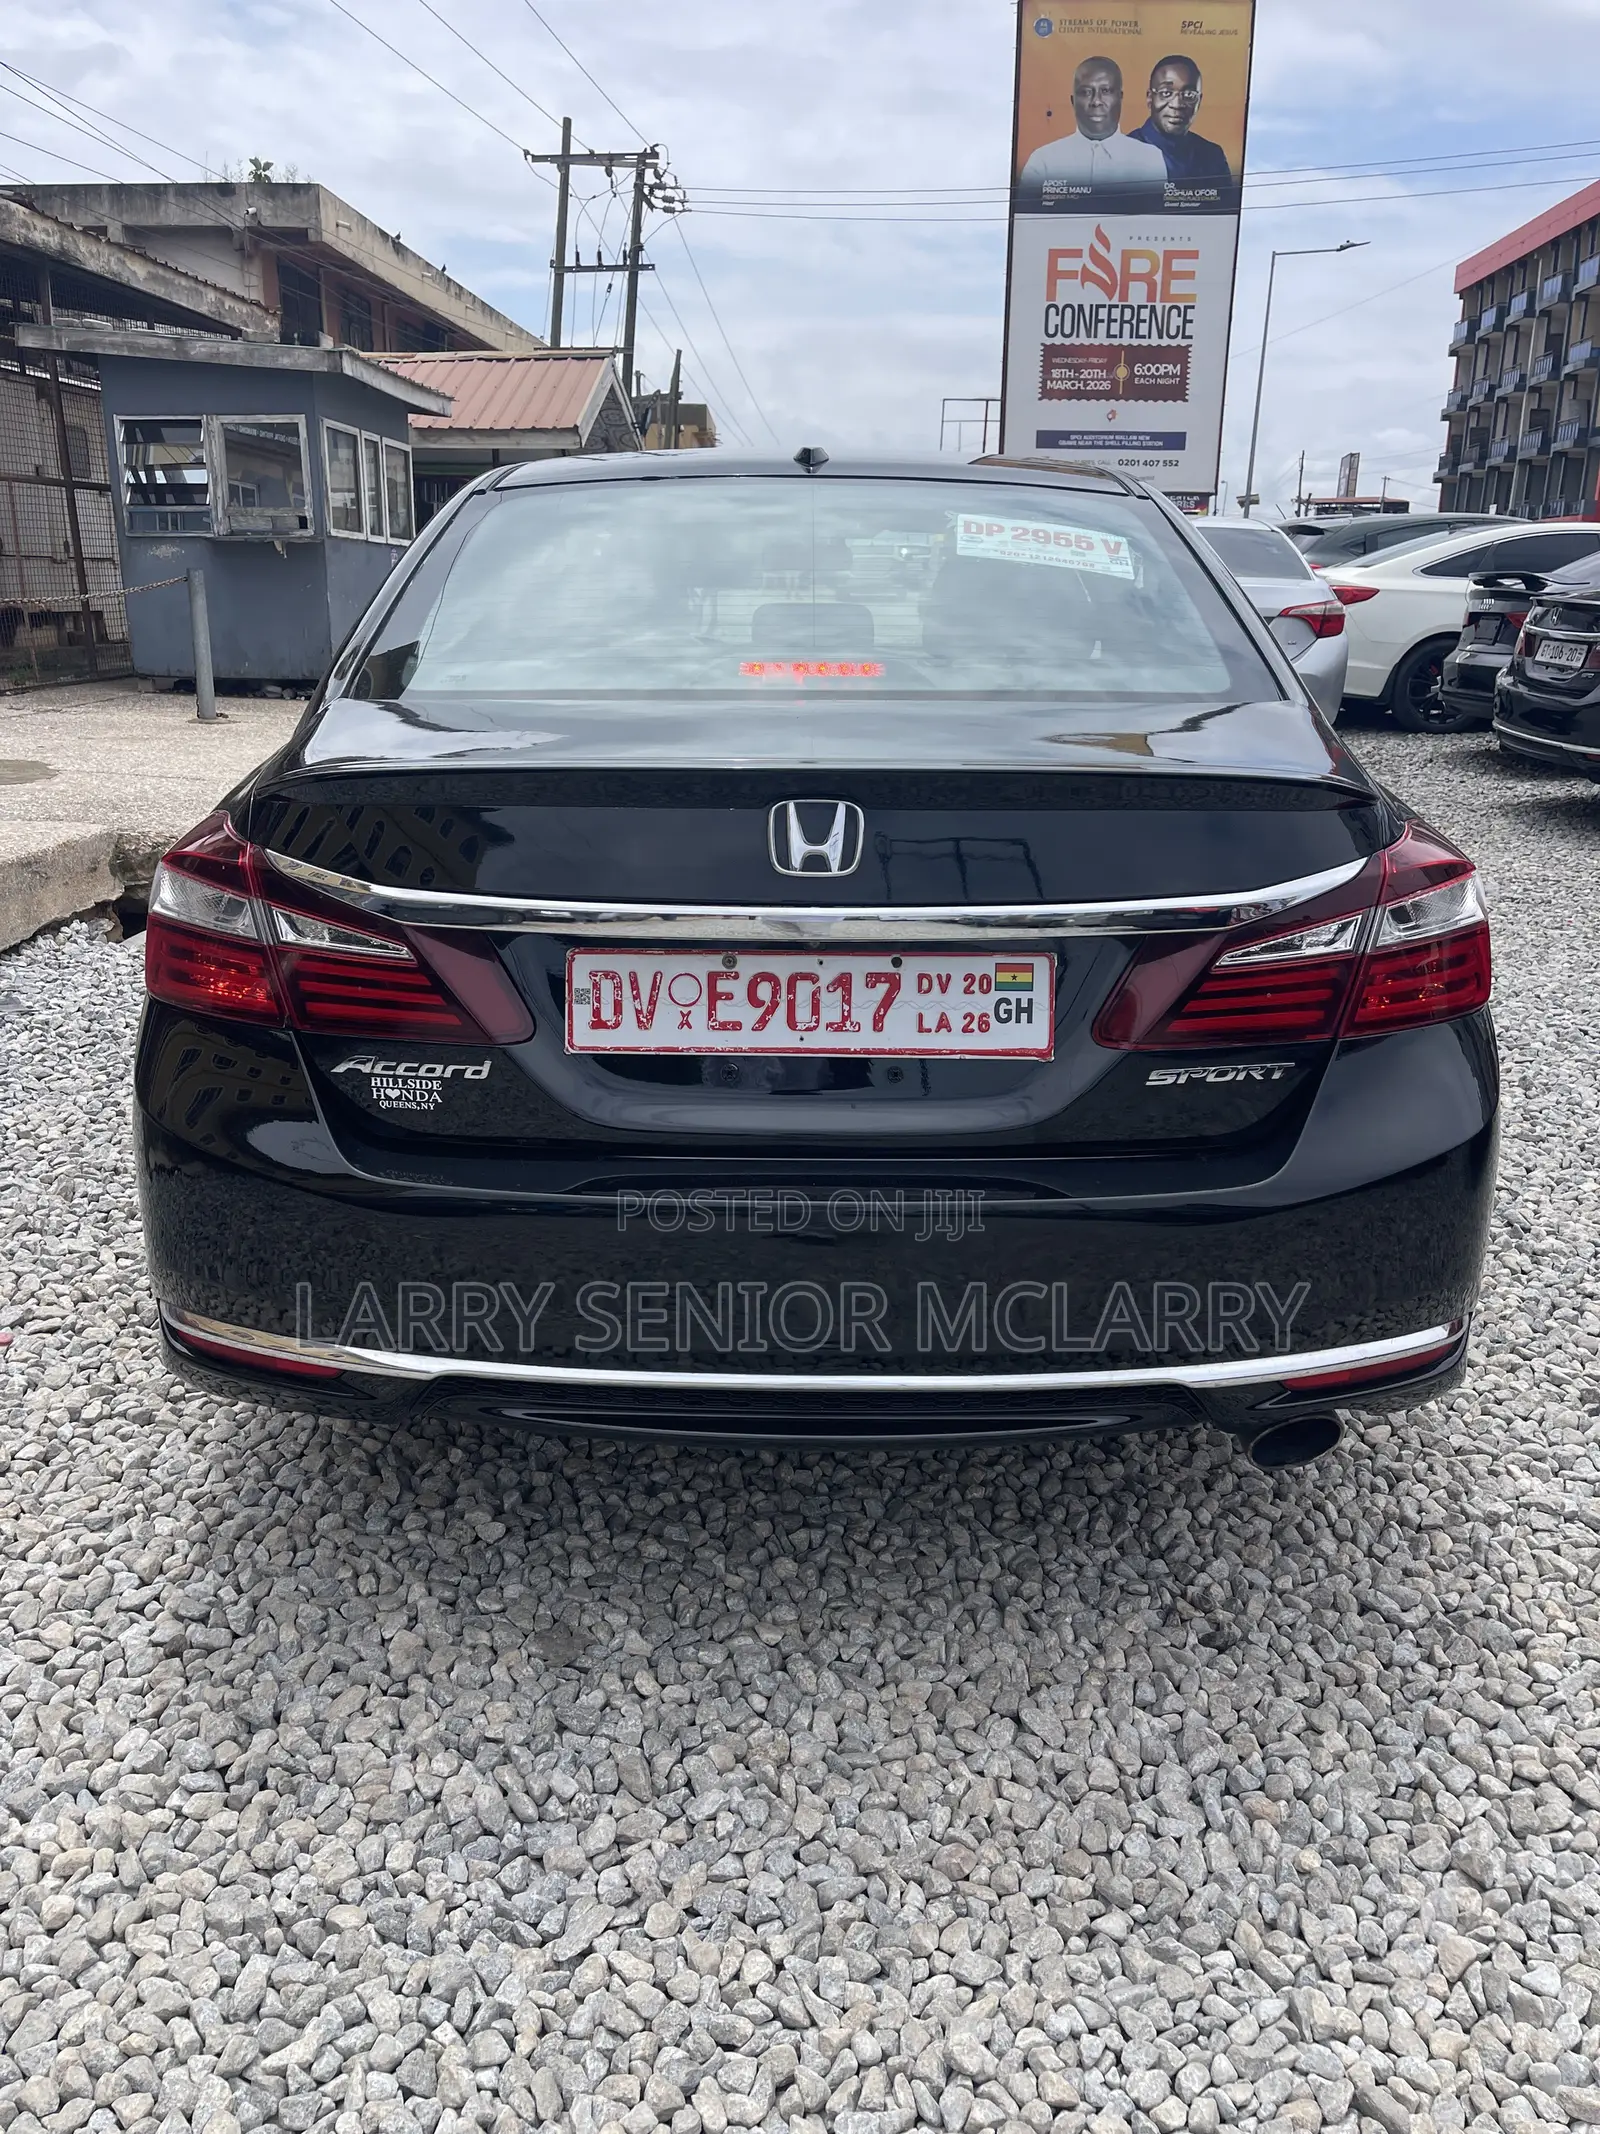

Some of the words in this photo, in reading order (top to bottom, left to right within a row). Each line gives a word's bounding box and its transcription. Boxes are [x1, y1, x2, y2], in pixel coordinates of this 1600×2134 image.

[1087, 27, 1142, 35] INTERNATIONAL
[1181, 20, 1203, 29] SPCI
[1044, 303, 1195, 339] CONFERENCE
[1134, 363, 1181, 376] 6:00PM
[1086, 380, 1112, 390] 2026
[1134, 377, 1155, 385] EACH
[1156, 377, 1180, 385] NIGHT
[1118, 459, 1140, 467] 0201
[1142, 459, 1160, 467] 407
[963, 520, 1005, 537] DP
[1101, 538, 1123, 555] V
[917, 973, 951, 994] DV
[963, 973, 992, 994] 20
[589, 970, 663, 1030] DV
[707, 971, 901, 1032] E9017
[994, 997, 1033, 1024] GH
[917, 1012, 952, 1033] LA
[961, 1012, 990, 1033] 26
[331, 1055, 493, 1080] Accord
[1145, 1062, 1296, 1086] SPORT
[371, 1077, 442, 1091] HILLSIDE
